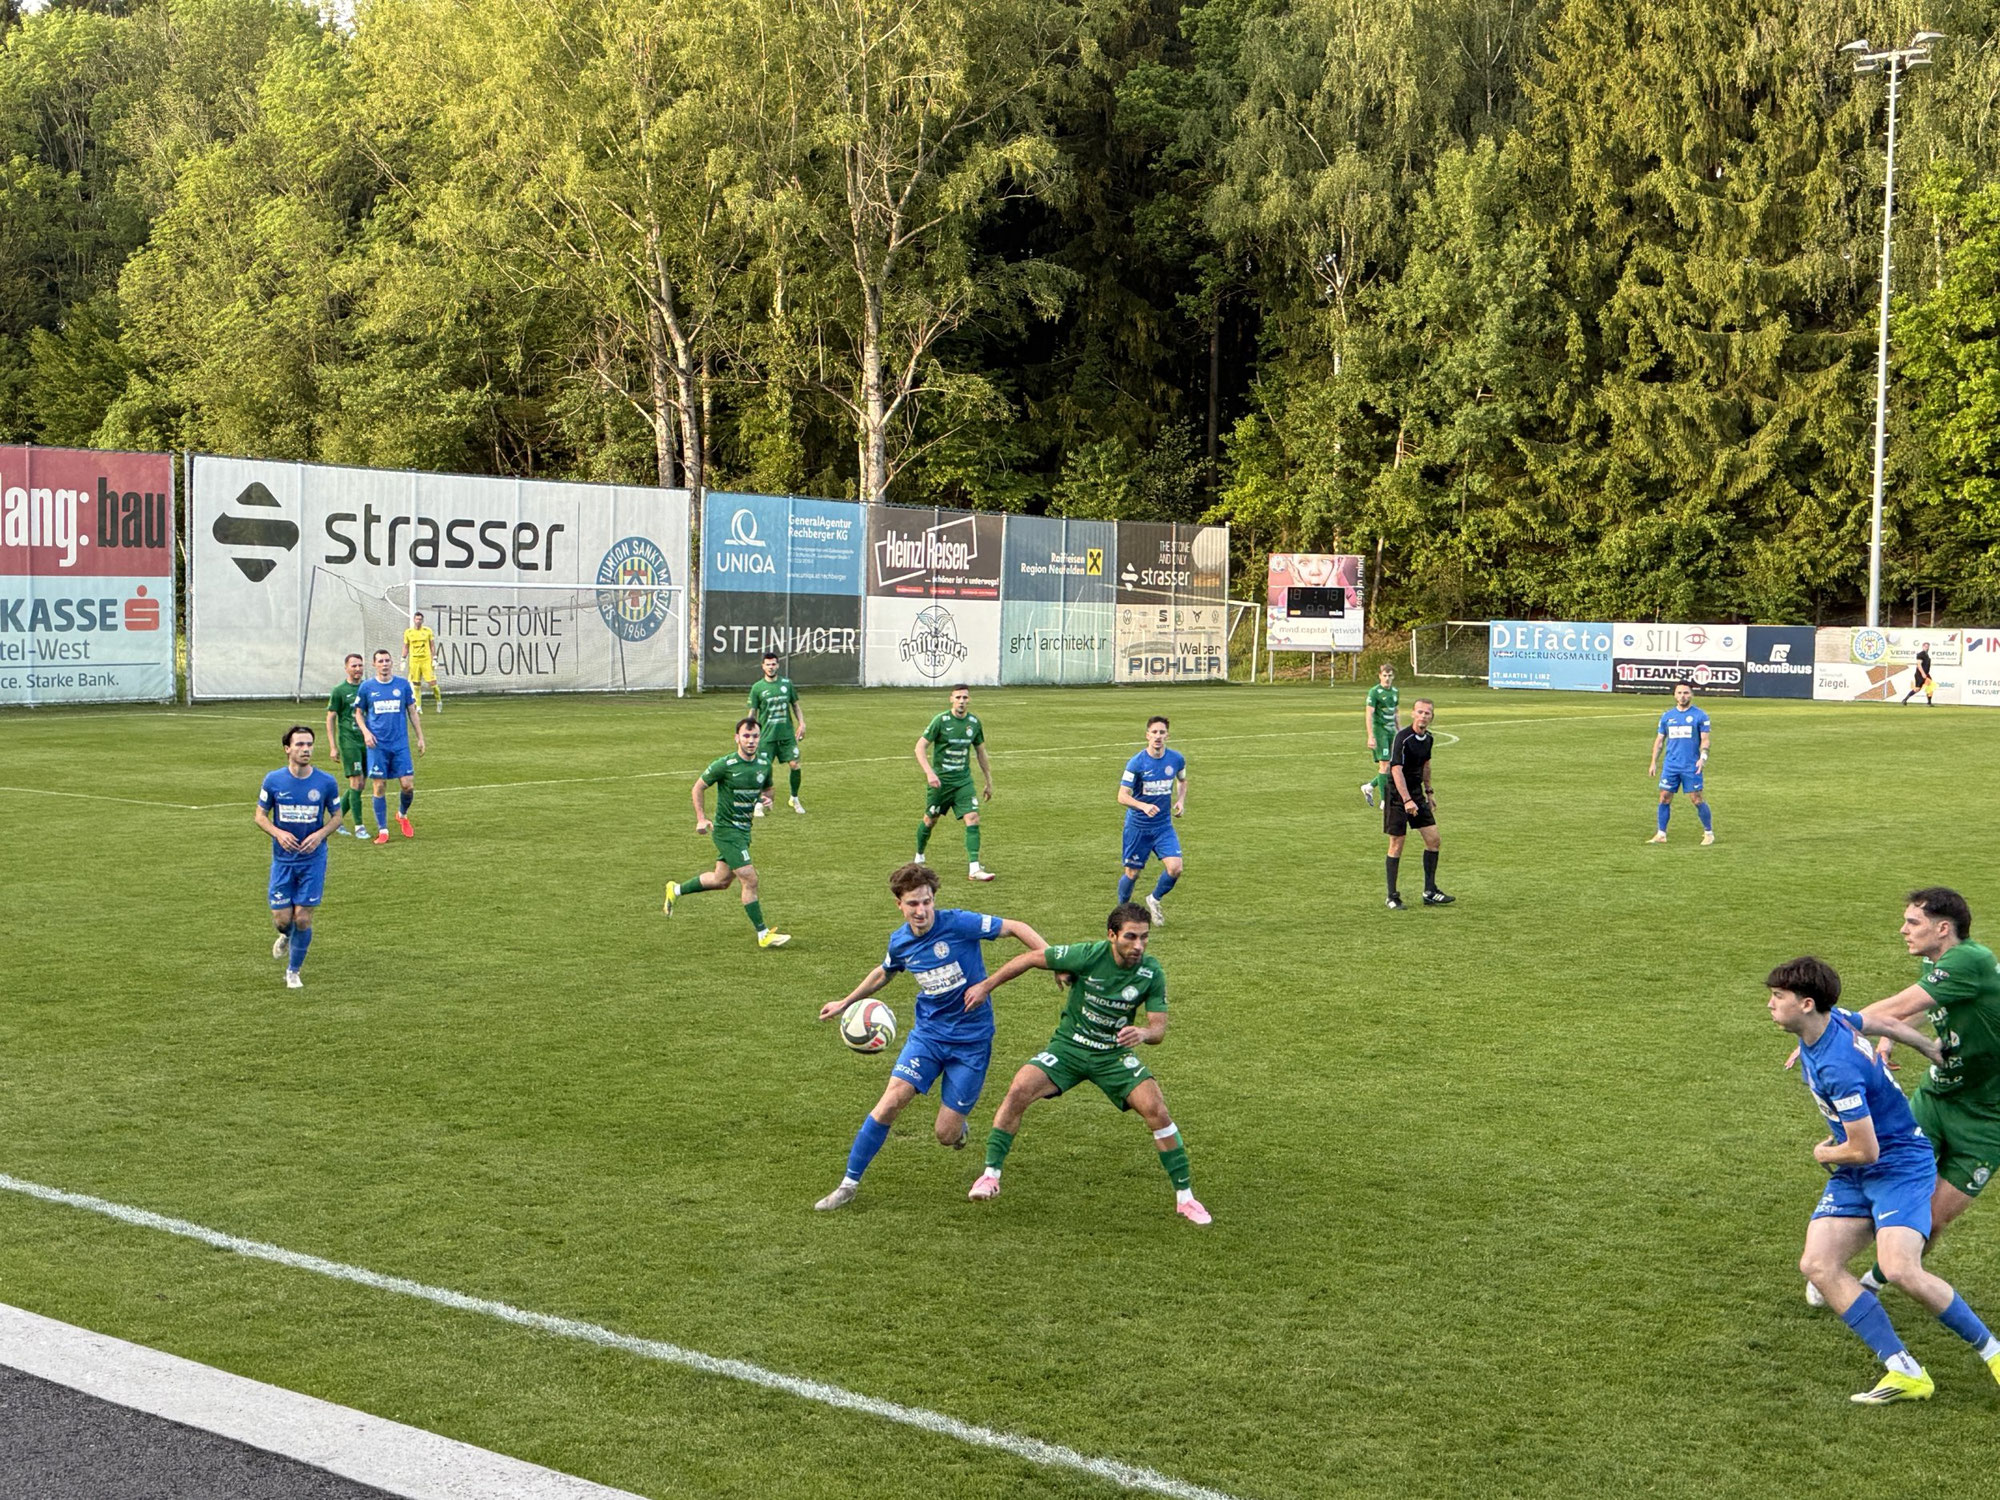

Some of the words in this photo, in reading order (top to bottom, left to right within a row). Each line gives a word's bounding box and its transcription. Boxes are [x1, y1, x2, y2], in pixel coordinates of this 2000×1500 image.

[0, 473, 89, 567] ang:
[98, 477, 165, 548] bau
[789, 514, 852, 529] GeneralAgentur
[325, 503, 565, 571] strasser
[788, 526, 834, 541] Rechberger
[836, 530, 848, 541] KG
[632, 540, 664, 569] SANKT
[886, 530, 926, 569] Heinzl
[926, 532, 970, 570] Reisen
[1159, 541, 1170, 552] THE
[716, 552, 776, 574] UNIQA
[1158, 553, 1171, 565] AND
[1020, 562, 1047, 576] Region
[1141, 567, 1190, 586] strasser
[0, 598, 118, 633] KASSE
[432, 605, 478, 636] THE
[487, 605, 562, 636] STONE
[623, 623, 647, 640] 1966
[712, 625, 856, 655] STEININGER
[1646, 629, 1682, 653] STIL
[436, 642, 487, 676] AND
[498, 642, 561, 675] ONLY
[1492, 651, 1609, 661] VERSICHERUNGSMAKLER
[1128, 656, 1222, 676] PICHLER
[1746, 662, 1813, 675] RoomBuus
[26, 673, 74, 689] Starke
[78, 672, 120, 687] Bank.
[1818, 678, 1850, 690] Ziegel.
